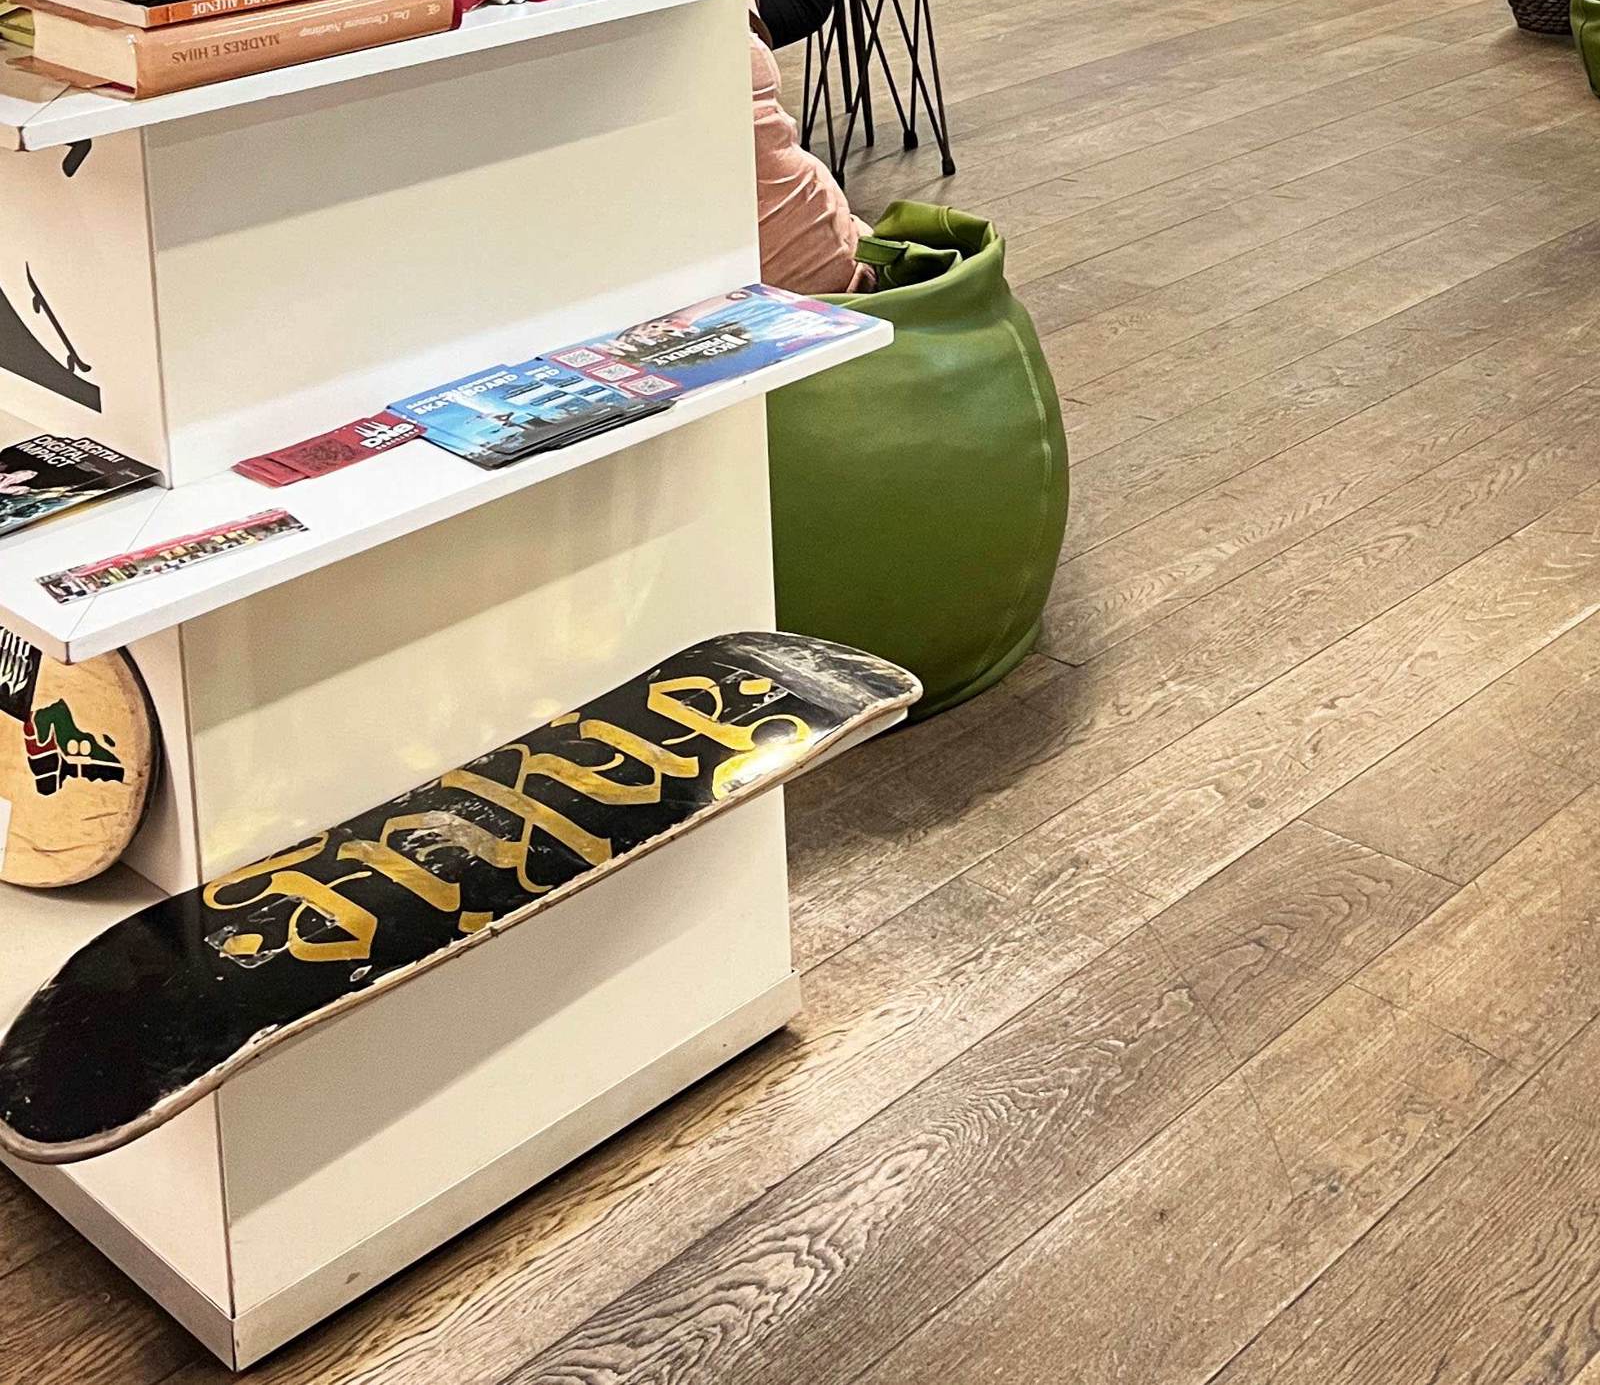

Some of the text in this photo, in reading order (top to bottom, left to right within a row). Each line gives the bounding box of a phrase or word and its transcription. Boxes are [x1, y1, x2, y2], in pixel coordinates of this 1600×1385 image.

[171, 34, 281, 64] MADRES E HIJAS
[16, 442, 76, 468] IMPACT
[33, 435, 89, 462] DIGITAL
